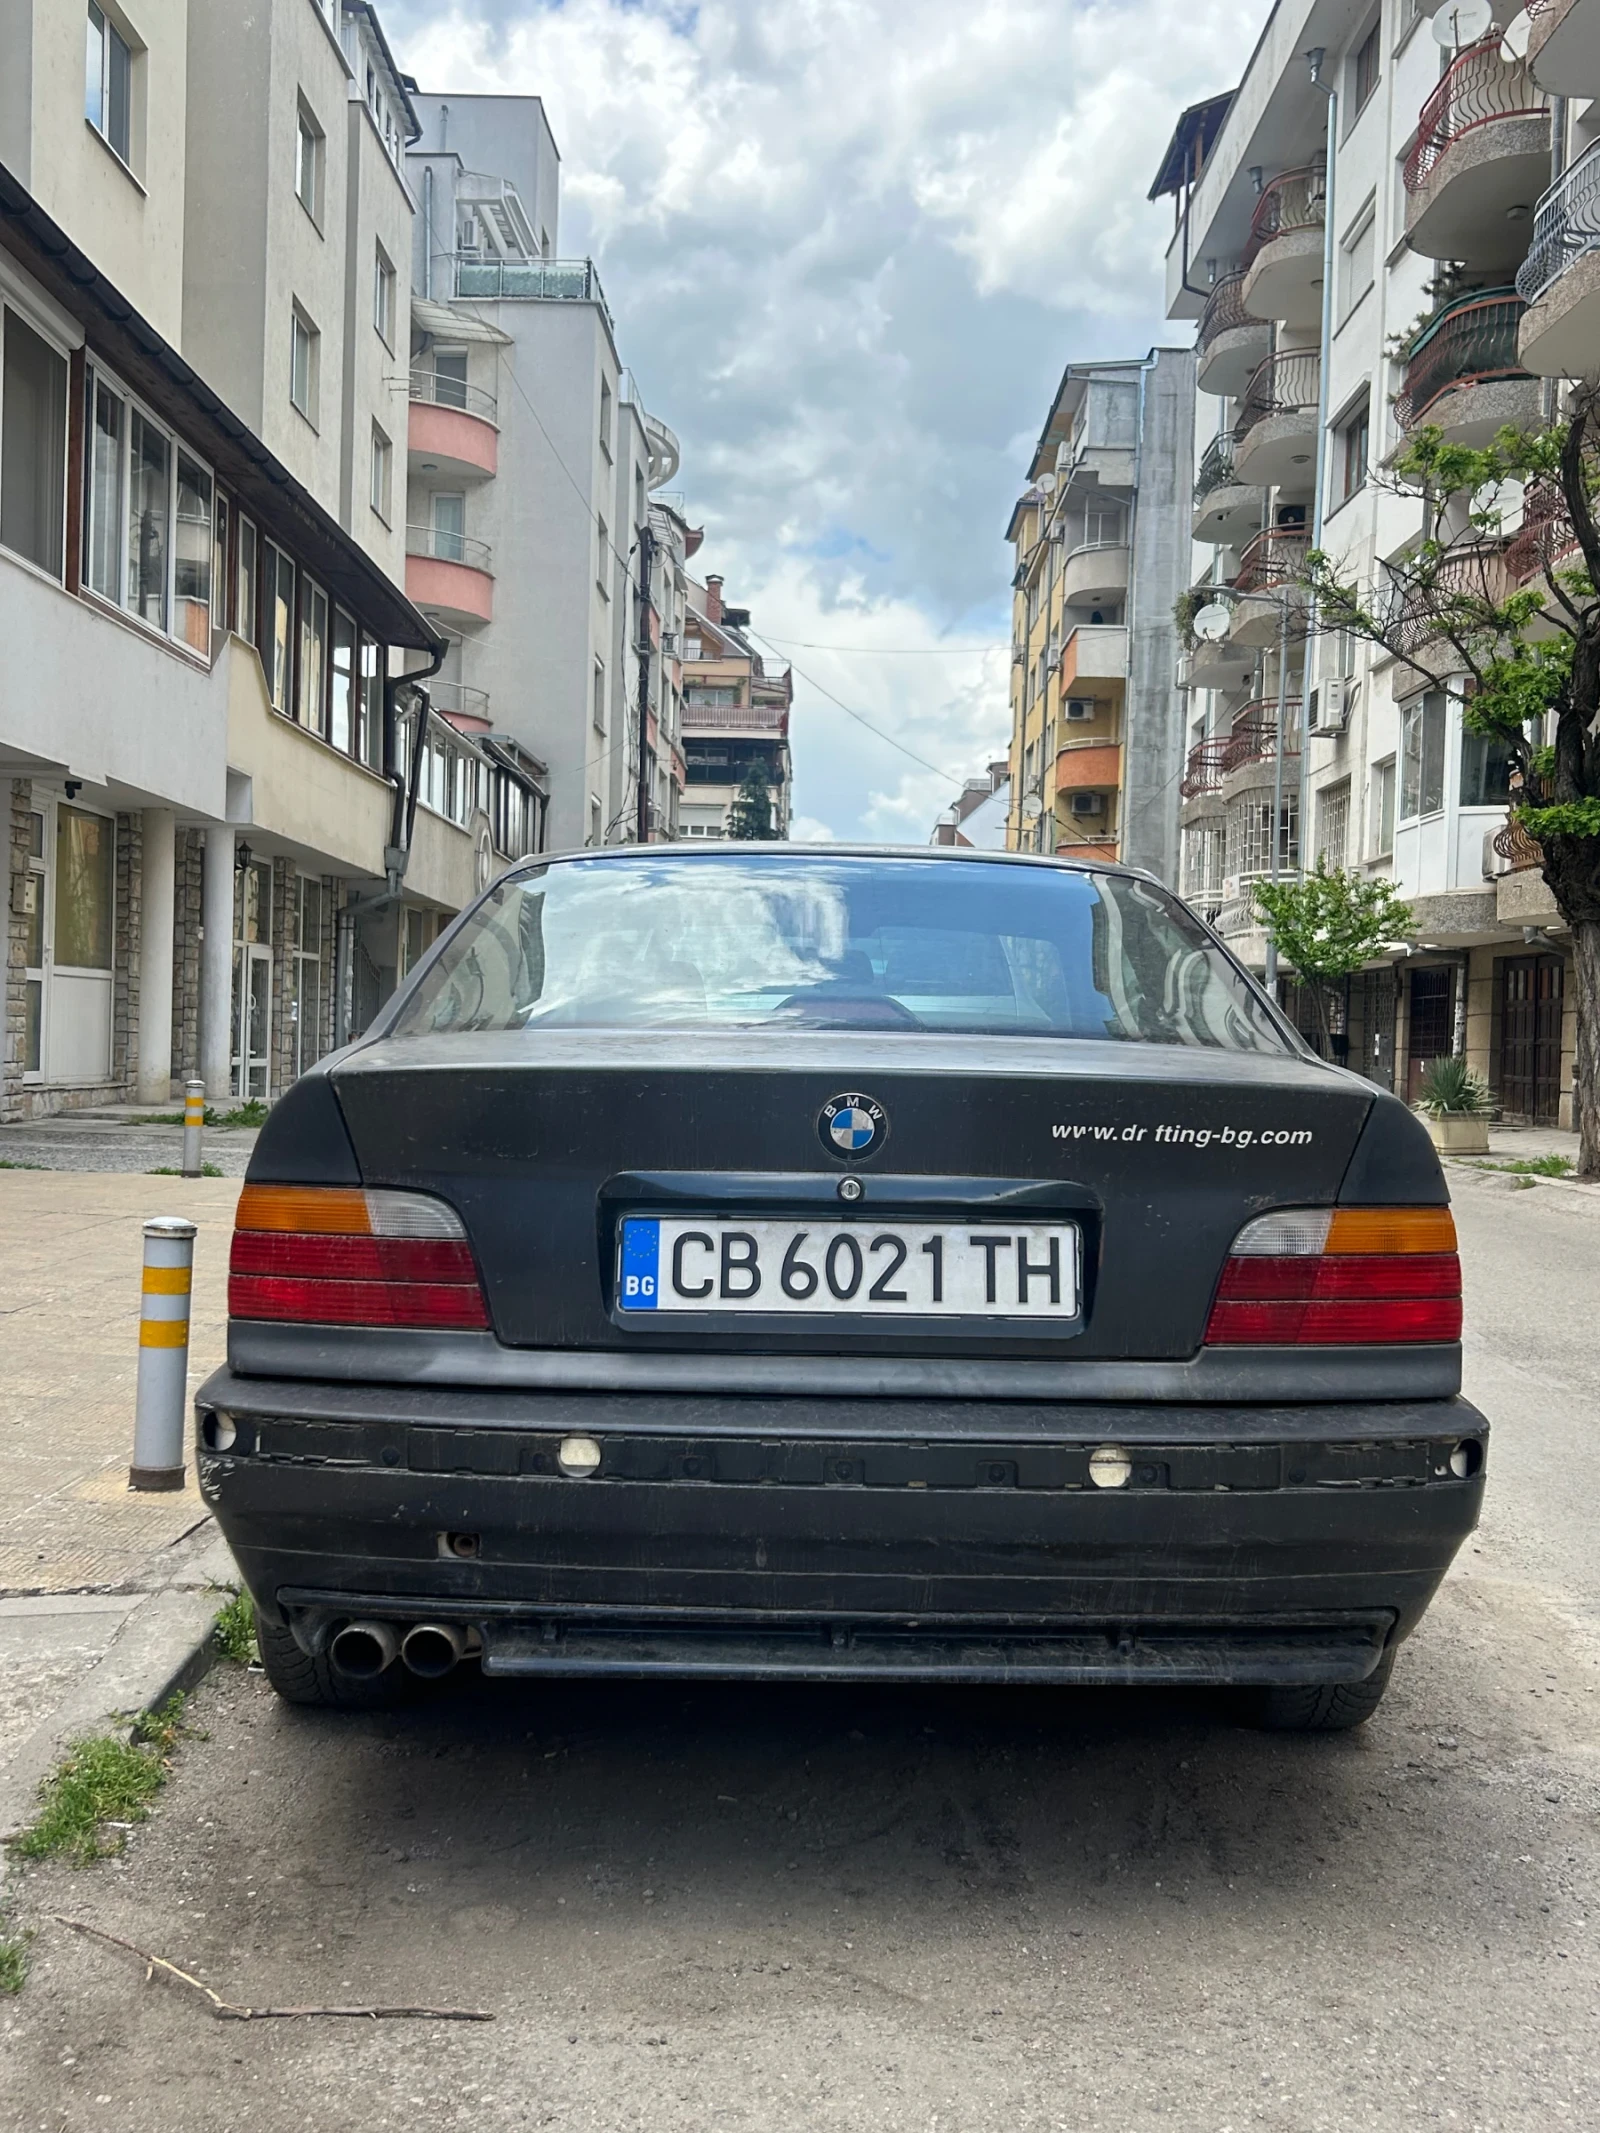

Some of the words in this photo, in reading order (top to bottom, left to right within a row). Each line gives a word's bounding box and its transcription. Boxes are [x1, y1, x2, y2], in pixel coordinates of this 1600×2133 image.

[824, 1096, 882, 1120] BMW
[1051, 1124, 1313, 1148] www.drfting-bg.com
[672, 1232, 761, 1299] CB
[780, 1233, 944, 1302] 6021
[970, 1236, 1061, 1304] TH
[626, 1275, 655, 1296] BG
